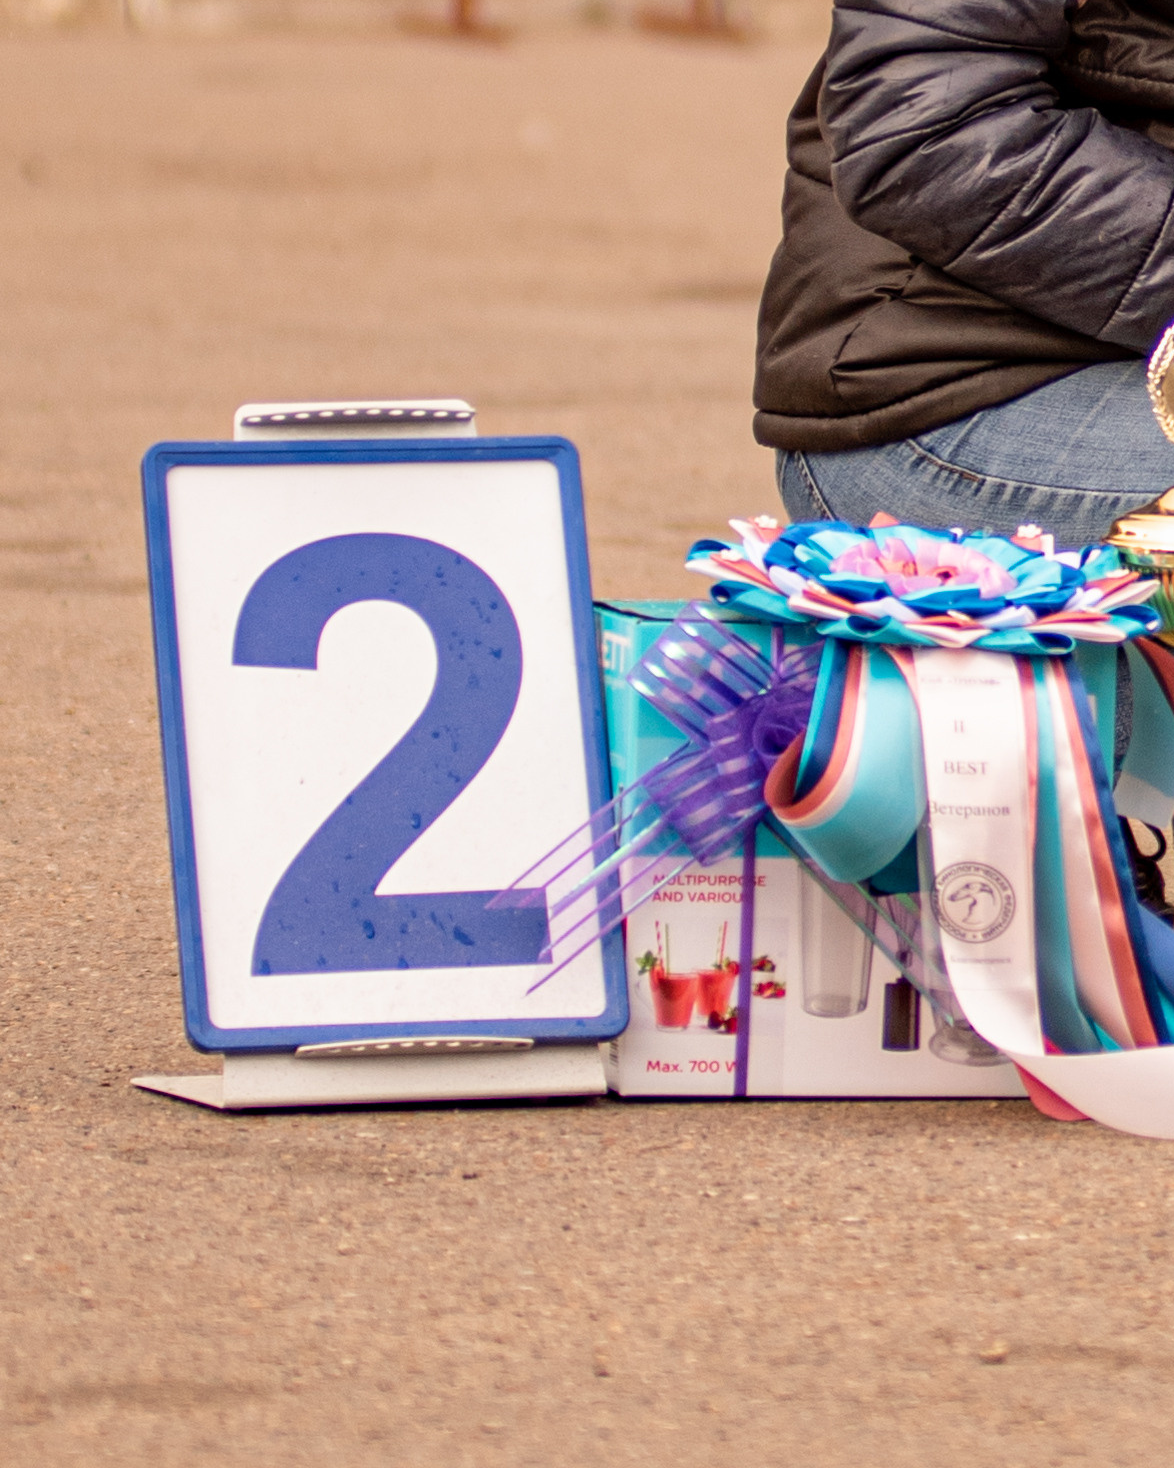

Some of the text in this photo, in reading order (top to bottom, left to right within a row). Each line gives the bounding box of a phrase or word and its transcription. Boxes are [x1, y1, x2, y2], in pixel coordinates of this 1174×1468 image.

[231, 532, 554, 977] 2
[944, 760, 990, 776] BEST
[652, 874, 767, 887] MULTIPURPE
[652, 891, 684, 903] AND
[646, 1060, 683, 1073] Max.
[688, 1060, 720, 1073] 700
